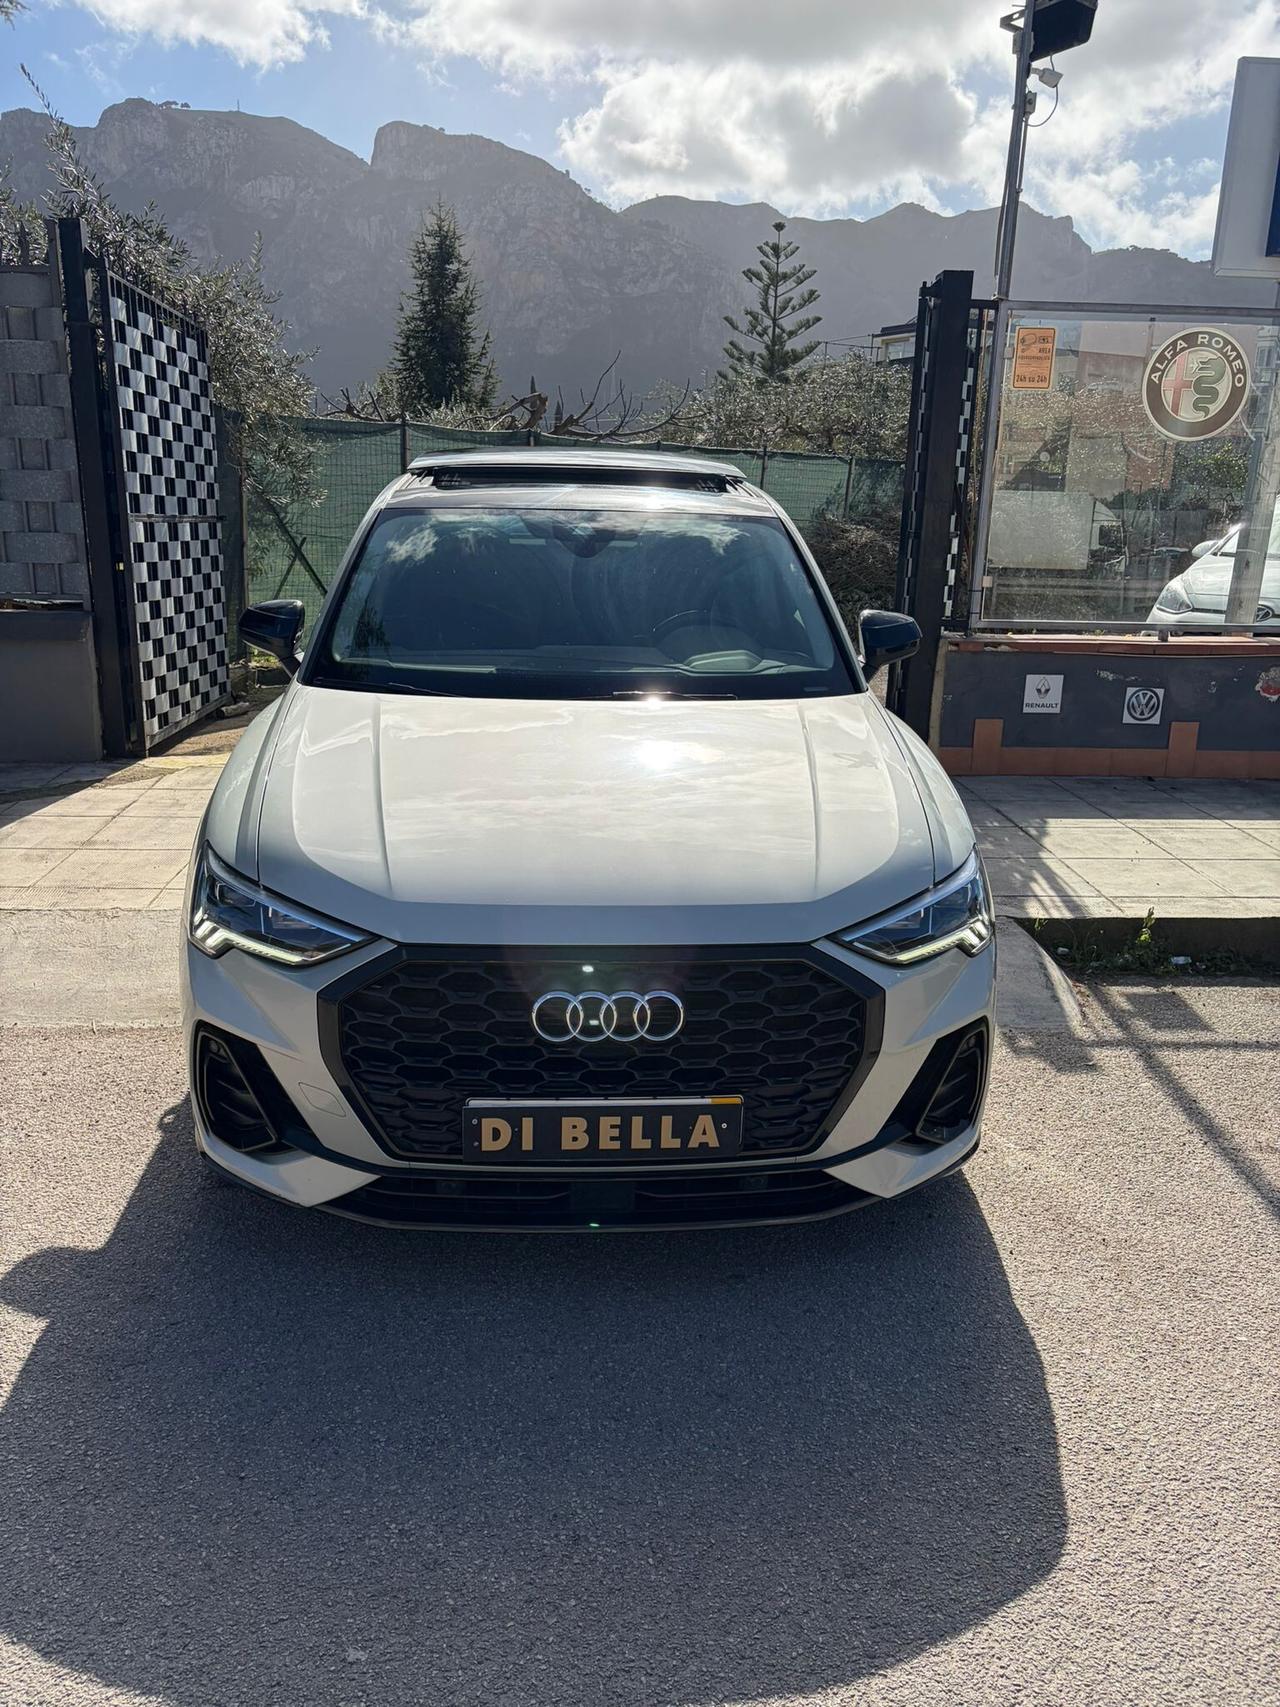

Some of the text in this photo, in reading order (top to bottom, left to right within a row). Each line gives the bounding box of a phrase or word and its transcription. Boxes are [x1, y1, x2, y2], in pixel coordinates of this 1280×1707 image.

[1150, 333, 1245, 388] ALFA ROMEO
[481, 1114, 720, 1151] DI BELLA
